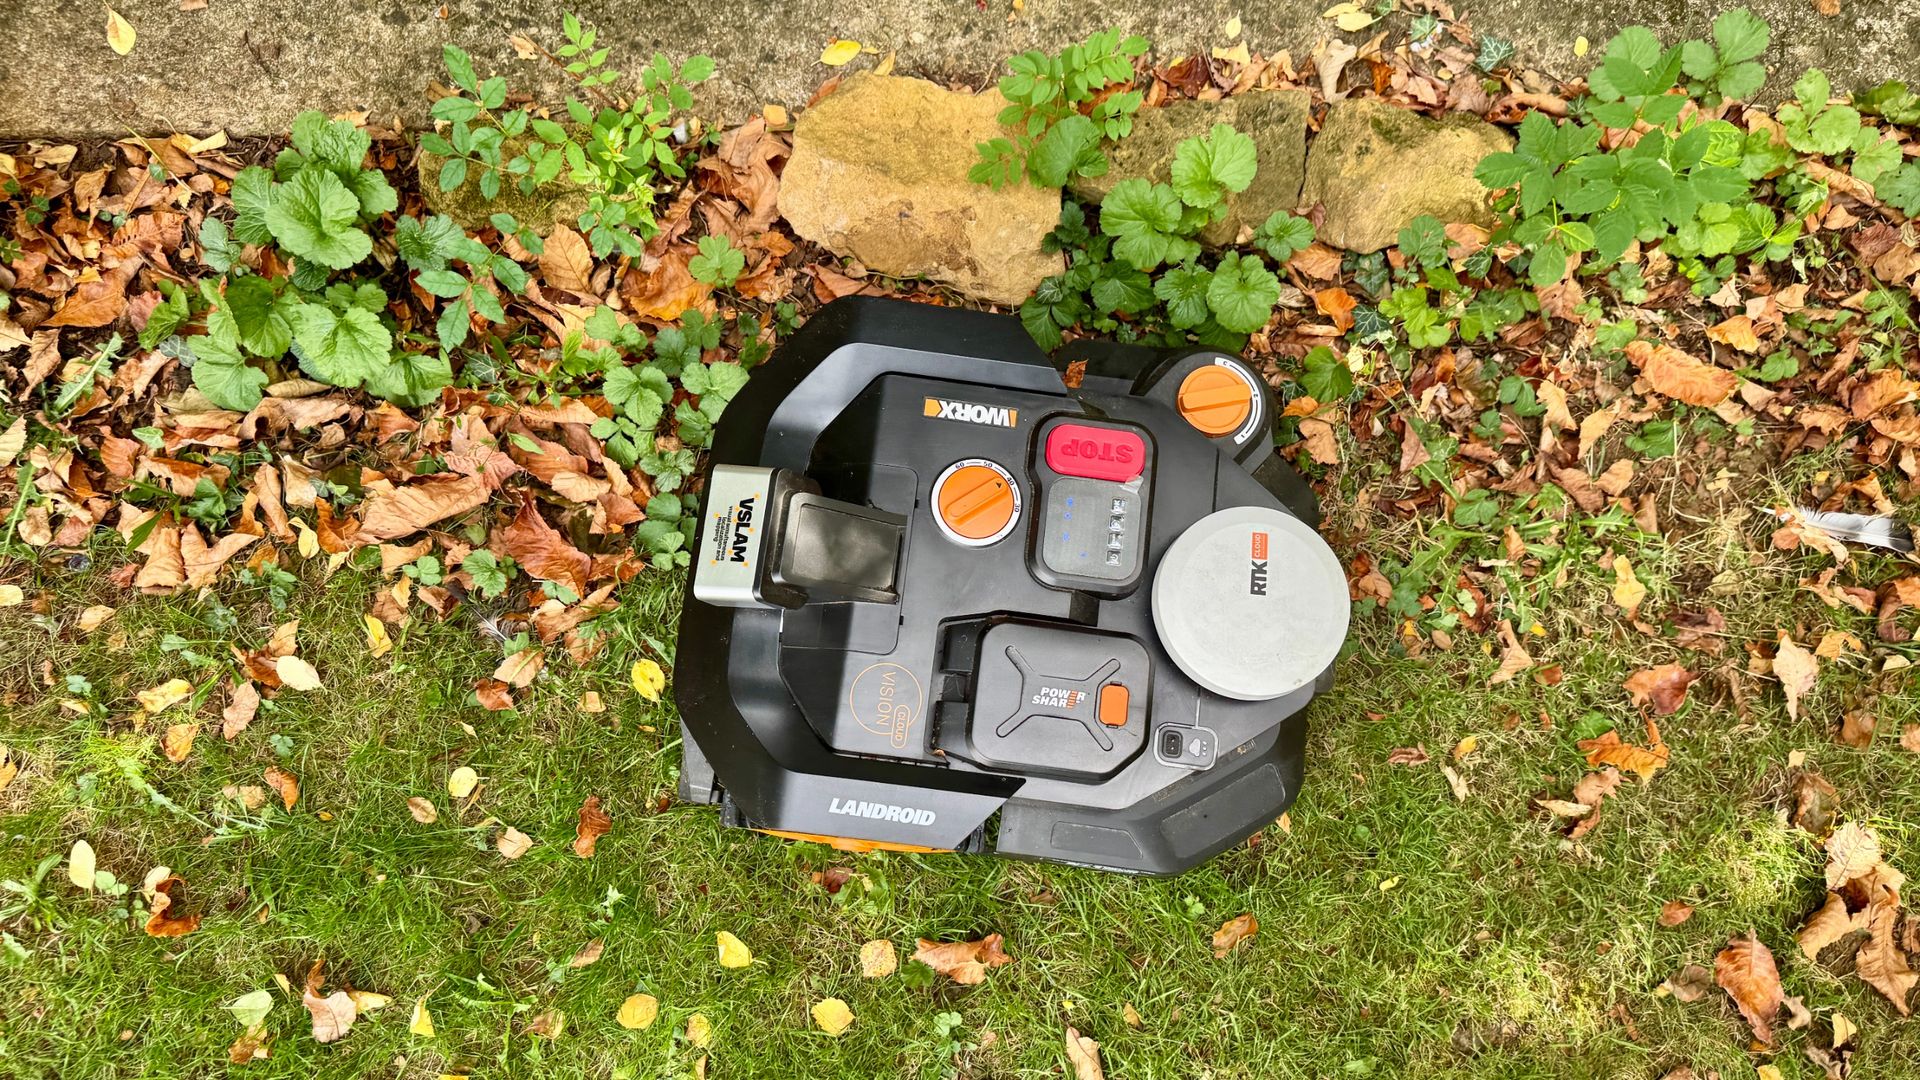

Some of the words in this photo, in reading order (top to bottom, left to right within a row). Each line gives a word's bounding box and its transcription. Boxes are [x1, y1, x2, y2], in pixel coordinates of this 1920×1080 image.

[937, 400, 1011, 427] WORX
[1060, 438, 1134, 464] STOP
[954, 461, 965, 470] 60
[1006, 476, 1015, 486] 40
[1014, 503, 1020, 513] 30
[713, 516, 722, 542] mapping
[730, 497, 755, 563] VSLAM
[1254, 533, 1262, 559] CLOUD
[1250, 560, 1268, 596] RTK
[876, 671, 897, 726] VISION
[1040, 686, 1086, 701] POWER
[895, 711, 906, 742] CLOUD
[828, 797, 937, 826] LANDROID
